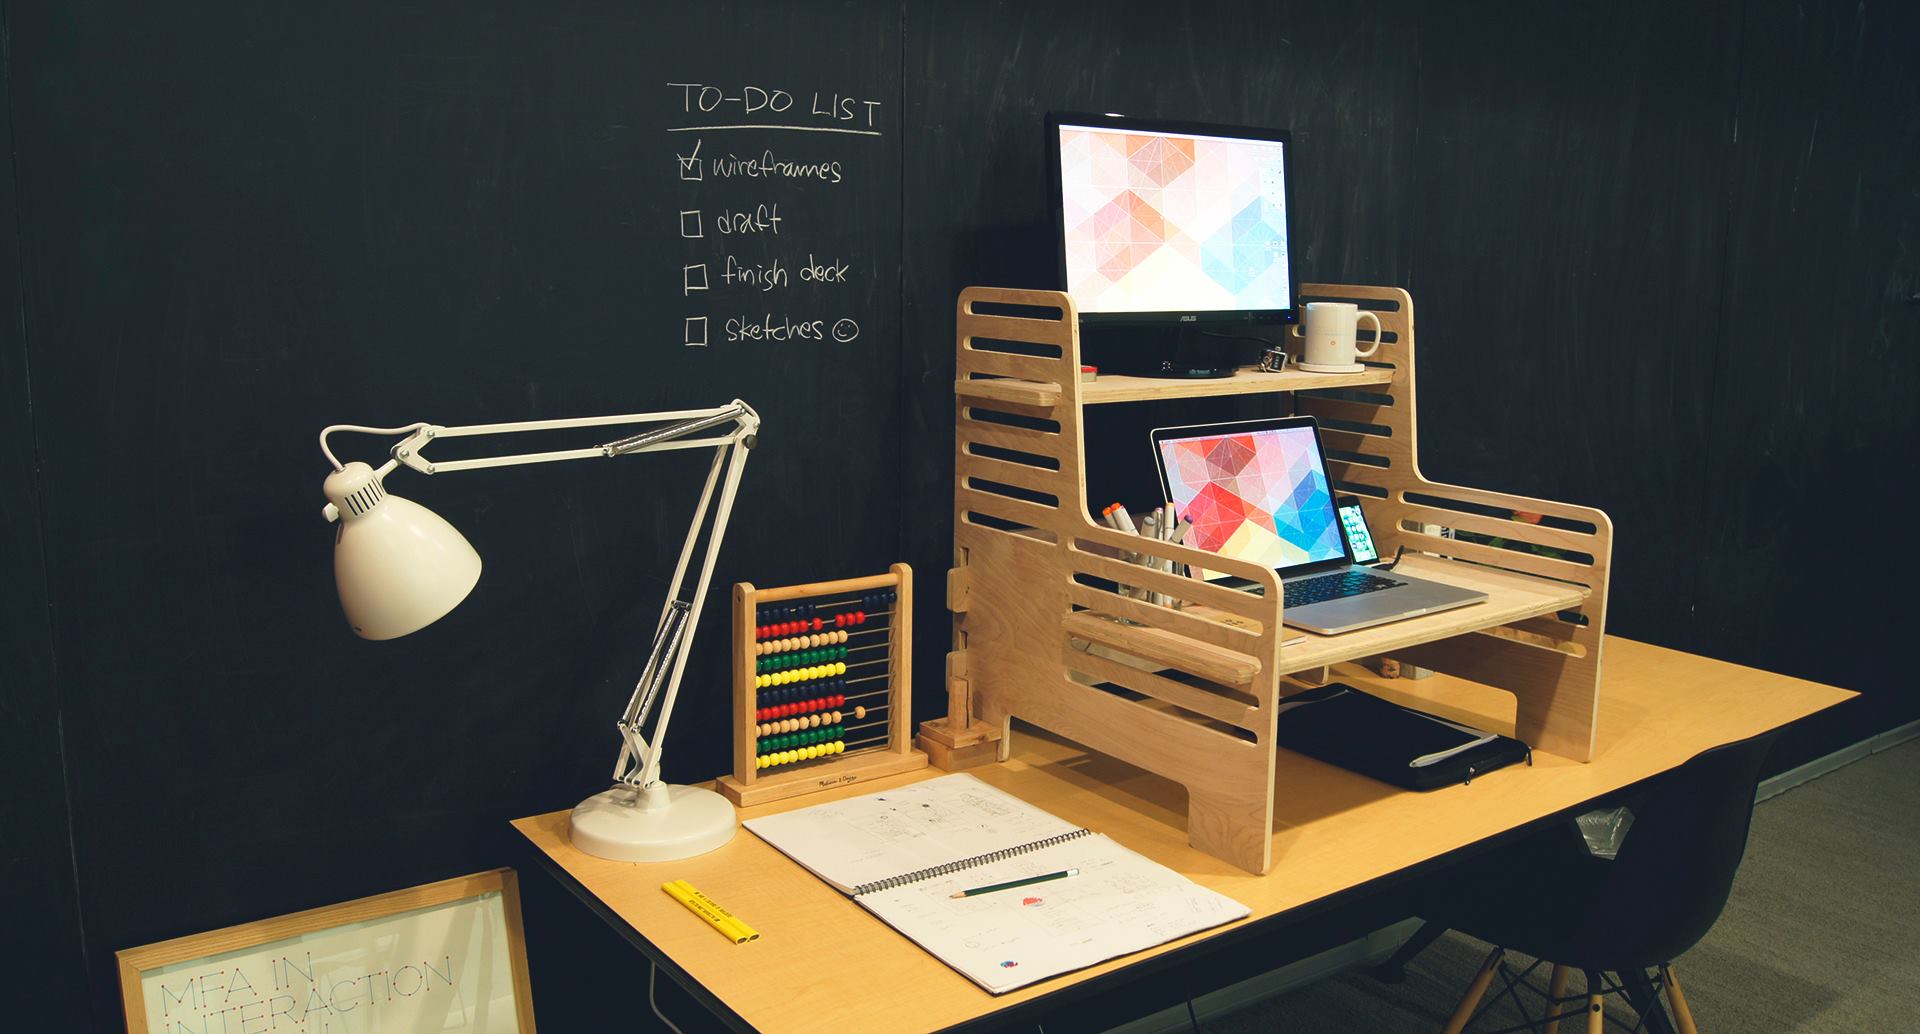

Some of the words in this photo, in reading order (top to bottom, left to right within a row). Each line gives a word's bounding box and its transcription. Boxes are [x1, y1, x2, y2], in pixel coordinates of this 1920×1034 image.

[667, 82, 794, 115] TO-DO
[811, 92, 881, 127] LIST
[713, 149, 842, 183] wireframes
[717, 203, 782, 235] draft
[721, 255, 788, 292] finish
[800, 253, 850, 283] deck
[725, 313, 824, 342] sketches
[161, 967, 258, 1017] MFA
[271, 950, 316, 991] IN
